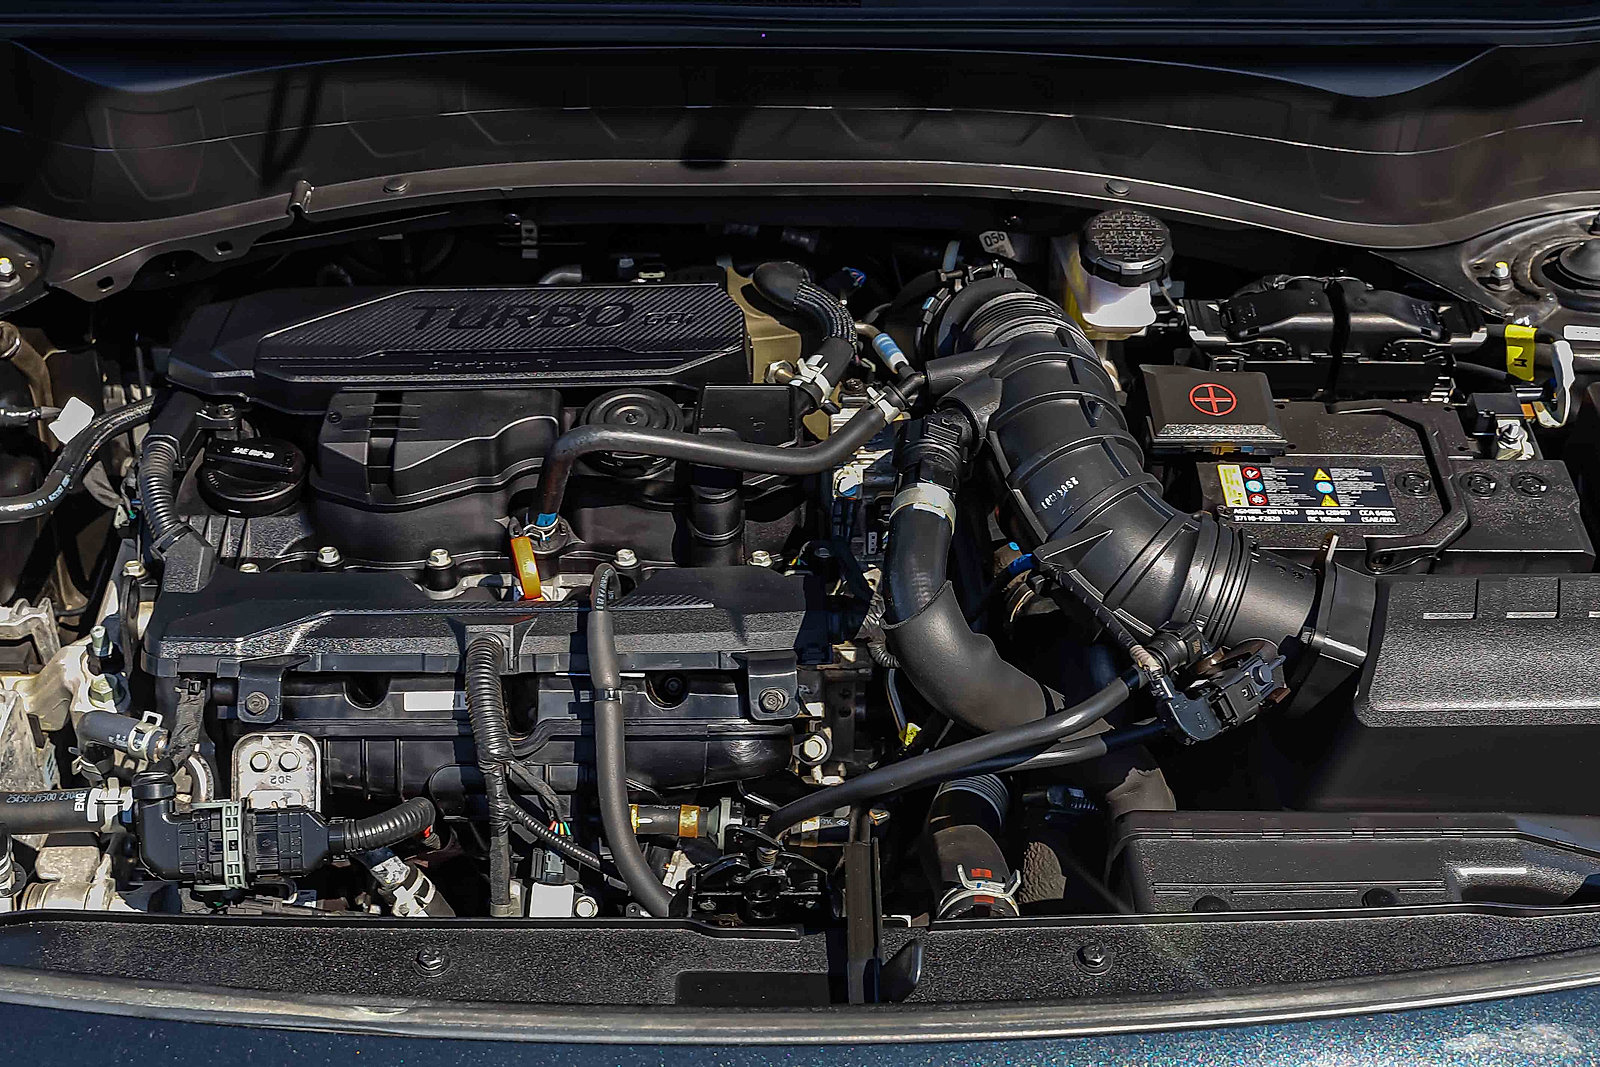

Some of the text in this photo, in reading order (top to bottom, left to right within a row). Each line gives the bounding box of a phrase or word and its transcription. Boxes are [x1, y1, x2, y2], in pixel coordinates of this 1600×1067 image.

[411, 303, 634, 331] TURBO
[231, 447, 249, 455] SAE
[74, 792, 87, 812] ENG
